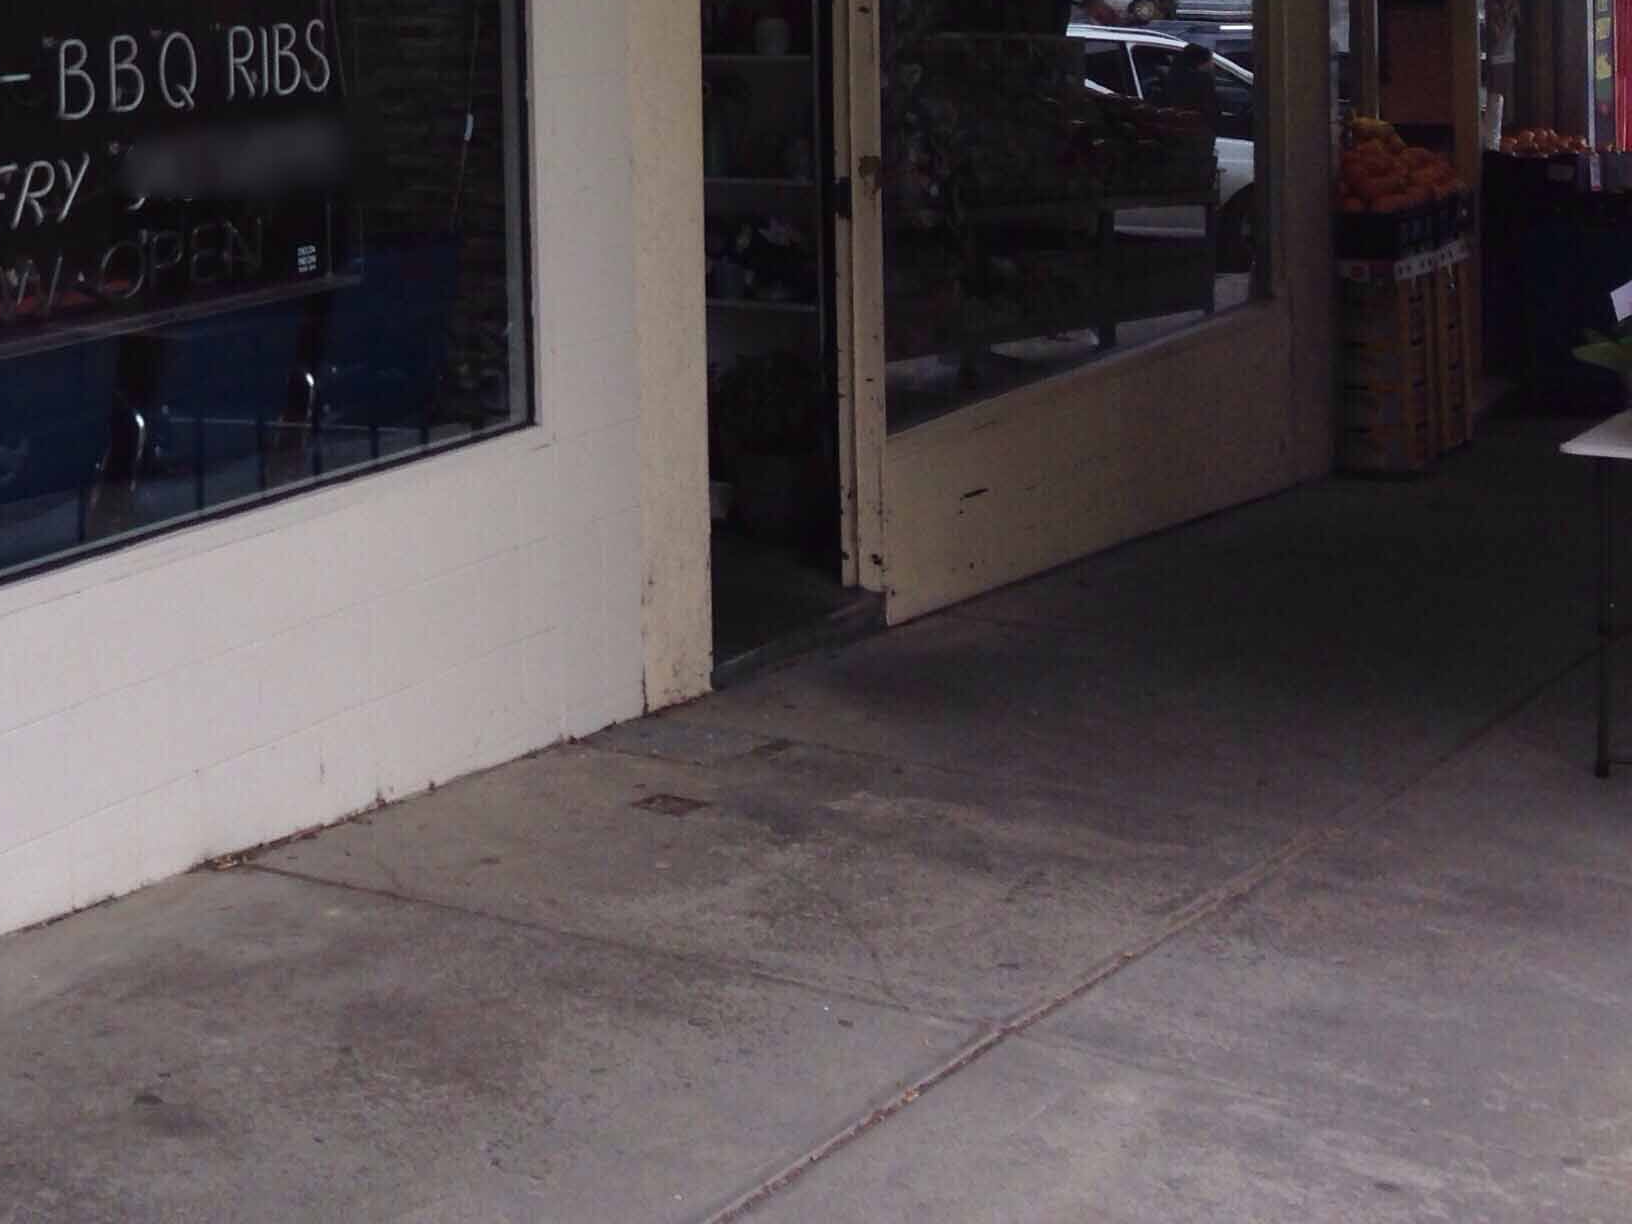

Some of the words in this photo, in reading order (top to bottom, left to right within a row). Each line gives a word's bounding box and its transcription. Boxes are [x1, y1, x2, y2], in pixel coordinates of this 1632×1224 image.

[57, 31, 199, 121] BBQ
[225, 19, 332, 102] RIBS
[97, 216, 265, 301] OPEN
